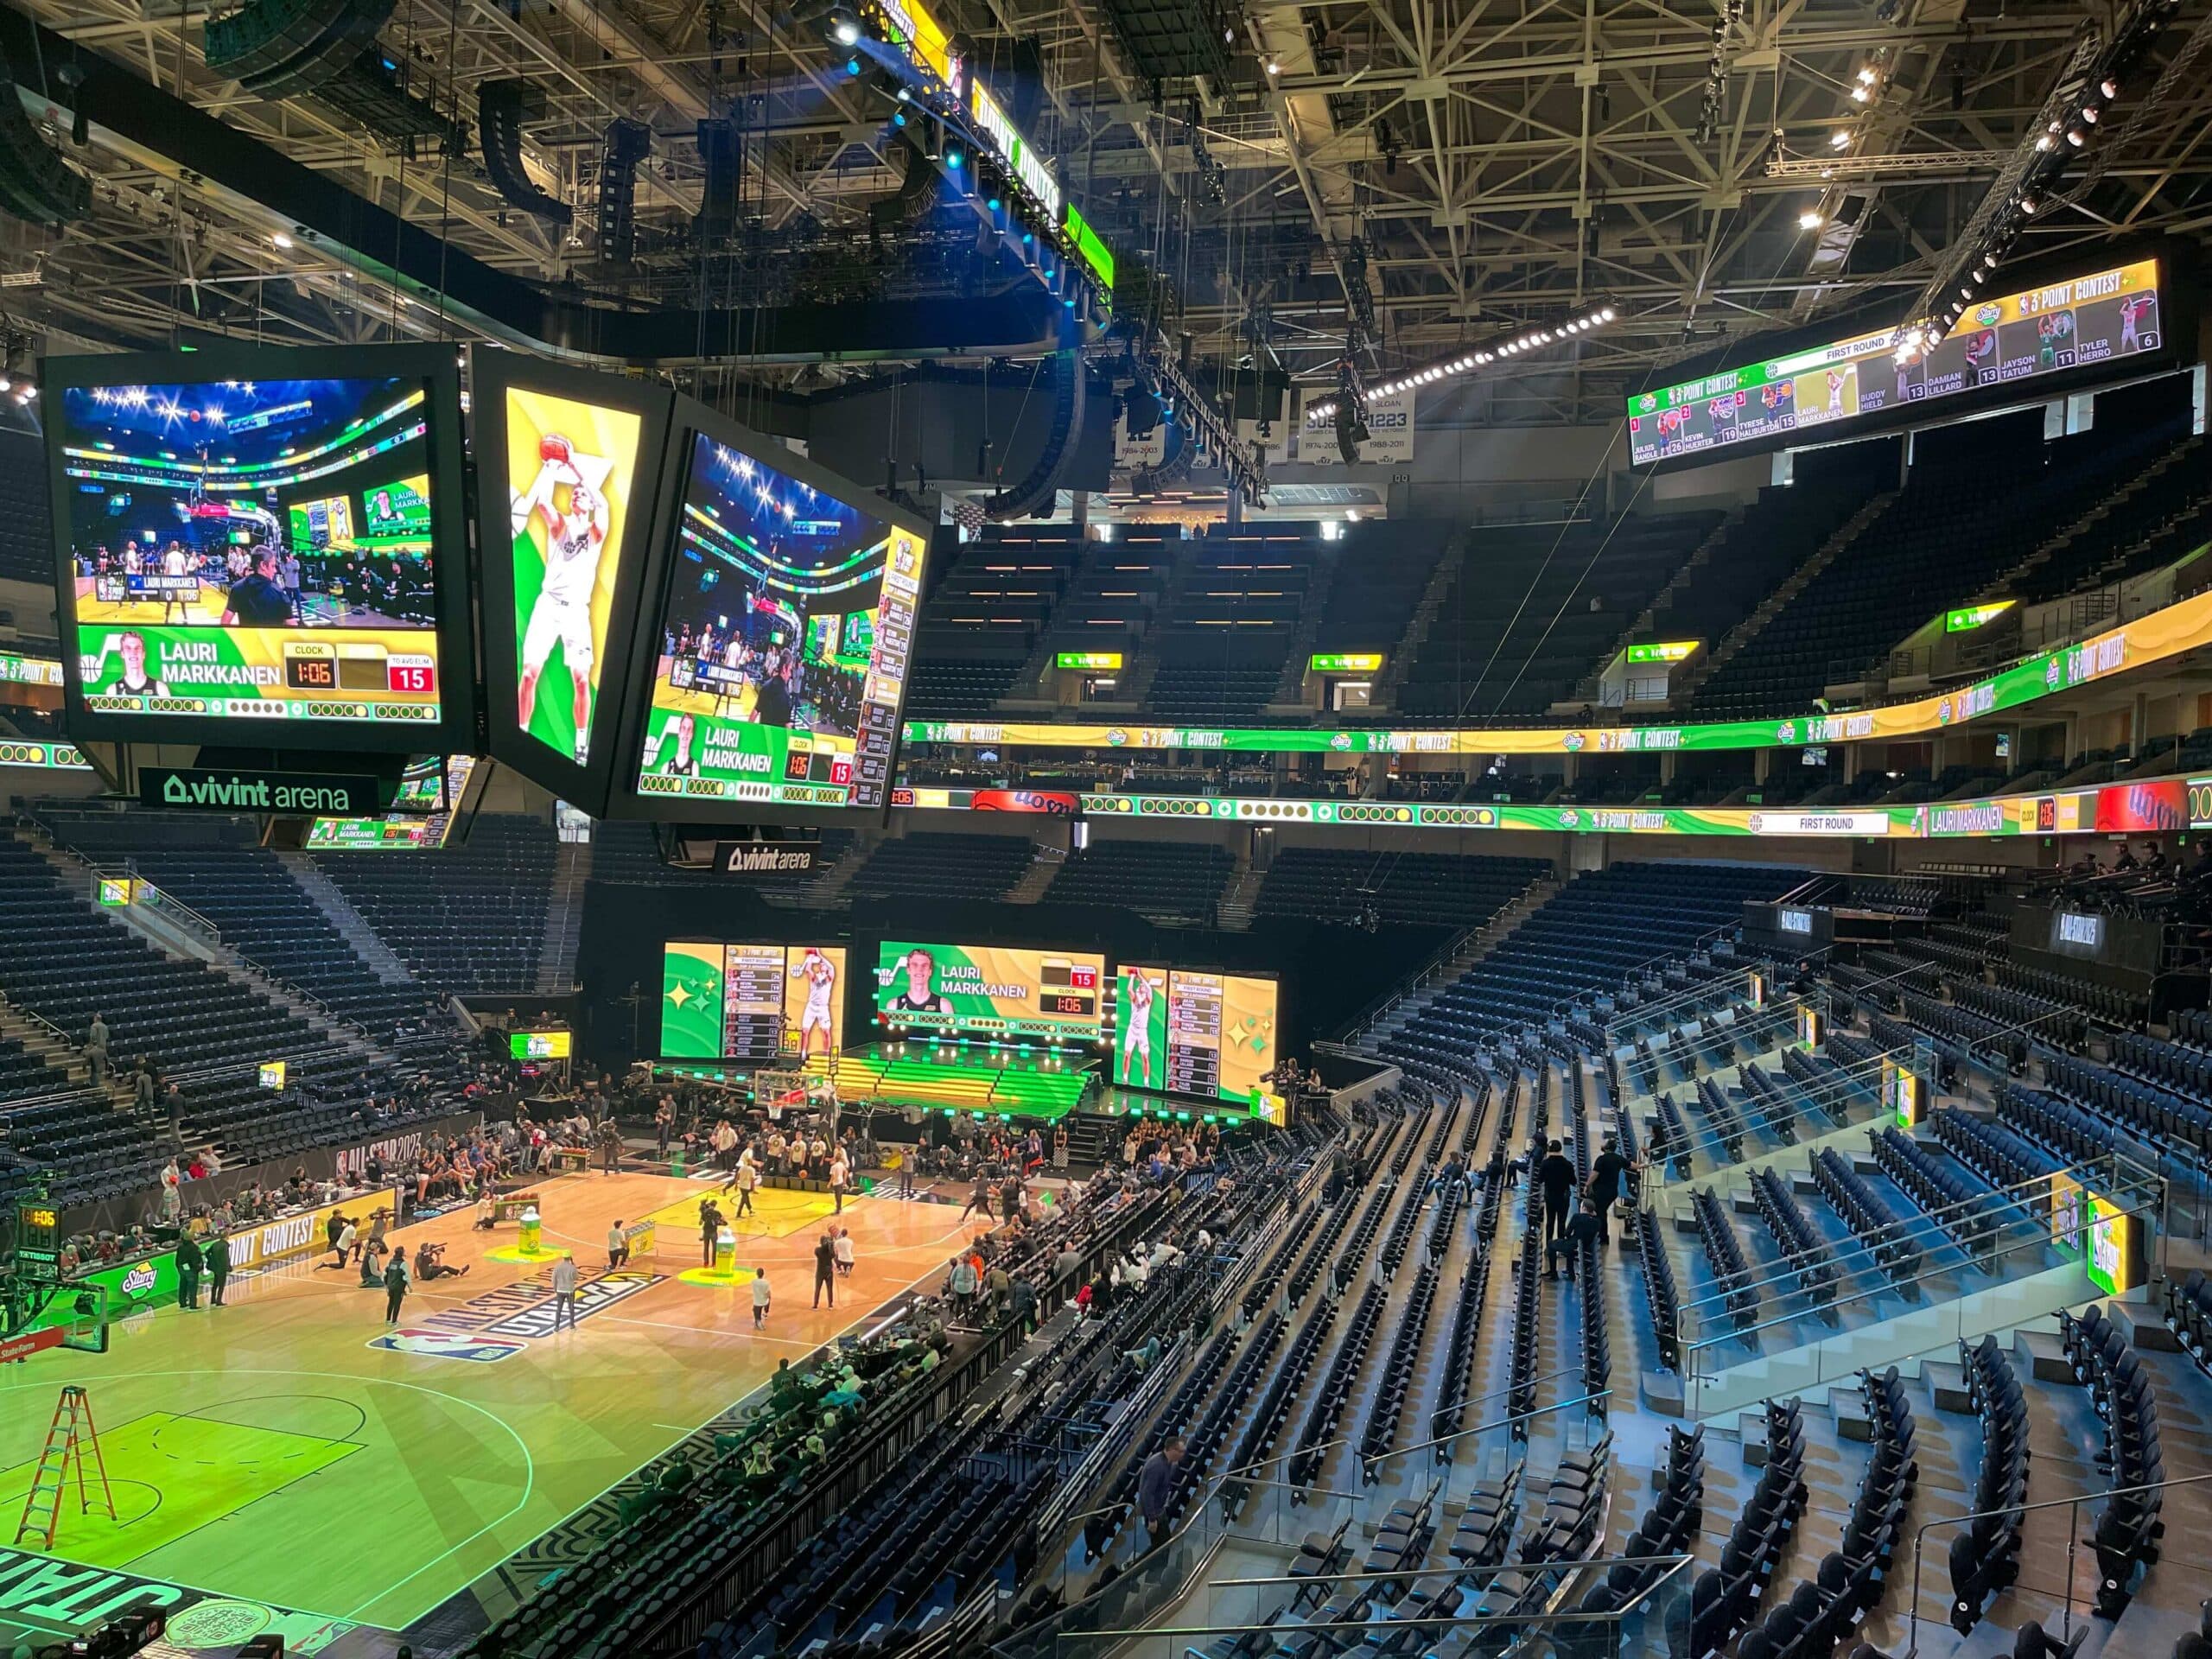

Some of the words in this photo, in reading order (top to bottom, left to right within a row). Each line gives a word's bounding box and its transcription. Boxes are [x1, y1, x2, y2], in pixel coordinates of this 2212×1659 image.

[2075, 271, 2122, 300] CONTEST
[2080, 339, 2108, 352] TYLER
[2144, 335, 2152, 346] 6
[1827, 346, 1852, 359] FIRST
[1854, 338, 1885, 353] ROUND
[2080, 347, 2111, 362] HERRO
[2002, 355, 2036, 370] JAYSON
[2060, 355, 2072, 365] 11
[1929, 372, 1961, 386] DAMIAN
[1983, 371, 1996, 381] 13
[2002, 365, 2032, 378] TATUM
[1707, 372, 1738, 394] CONTEST
[1929, 381, 1962, 395] LILLARD
[1738, 394, 1744, 403] 3
[1860, 390, 1886, 403] BUDDY
[1910, 387, 1923, 397] 13
[1683, 408, 1689, 416] 2
[1797, 406, 1819, 416] LAURI
[1861, 399, 1883, 410] HIELD
[1369, 414, 1407, 427] 1223
[1738, 418, 1764, 429] TYRESE
[1783, 418, 1794, 429] 15
[1798, 408, 1844, 424] MARKKANEN
[1685, 432, 1703, 442] KEVIN
[1726, 430, 1736, 441] 19
[1738, 423, 1780, 438] HALIBURTON
[1635, 443, 1655, 454] JULIUS
[1672, 442, 1681, 452] 26
[1686, 437, 1713, 450] HUERTER
[1635, 450, 1658, 461] RANDLE
[393, 491, 416, 500] LAURI
[166, 591, 172, 600] 0
[160, 642, 217, 662] LAURI
[162, 664, 281, 685] MARKKANEN
[297, 663, 332, 683] 1:06
[399, 670, 424, 689] 15
[1847, 715, 1873, 736] CONTEST
[705, 726, 740, 747] LAURI
[969, 726, 1002, 741] CONTEST
[1188, 732, 1224, 747] CONTEST
[1644, 730, 1681, 747] CONTEST
[1415, 735, 1451, 751] CONTEST
[702, 749, 772, 773] MARKKANEN
[790, 756, 807, 774] 1:06
[836, 765, 847, 782] 15
[191, 776, 270, 806] vivint
[276, 787, 349, 810] arena
[892, 792, 912, 804] 1:06
[1632, 813, 1665, 829] CONTEST
[1931, 810, 1955, 832] LAURI
[1957, 806, 2003, 830] MARKKANEN
[2040, 803, 2053, 826] 1:06
[1800, 818, 1823, 830] FIRST
[1825, 817, 1853, 830] ROUND
[743, 847, 779, 869] vivint
[779, 851, 810, 869] arena
[941, 965, 980, 980] LAURI
[1077, 975, 1090, 985] 15
[940, 981, 1027, 998] MARKKANEN
[1058, 997, 1081, 1012] 1:06
[397, 1132, 422, 1161] 2023
[34, 1211, 55, 1227] 1:06
[262, 1216, 318, 1256] CONTEST
[123, 1266, 159, 1294] Starry
[0, 1553, 182, 1626] UTA
